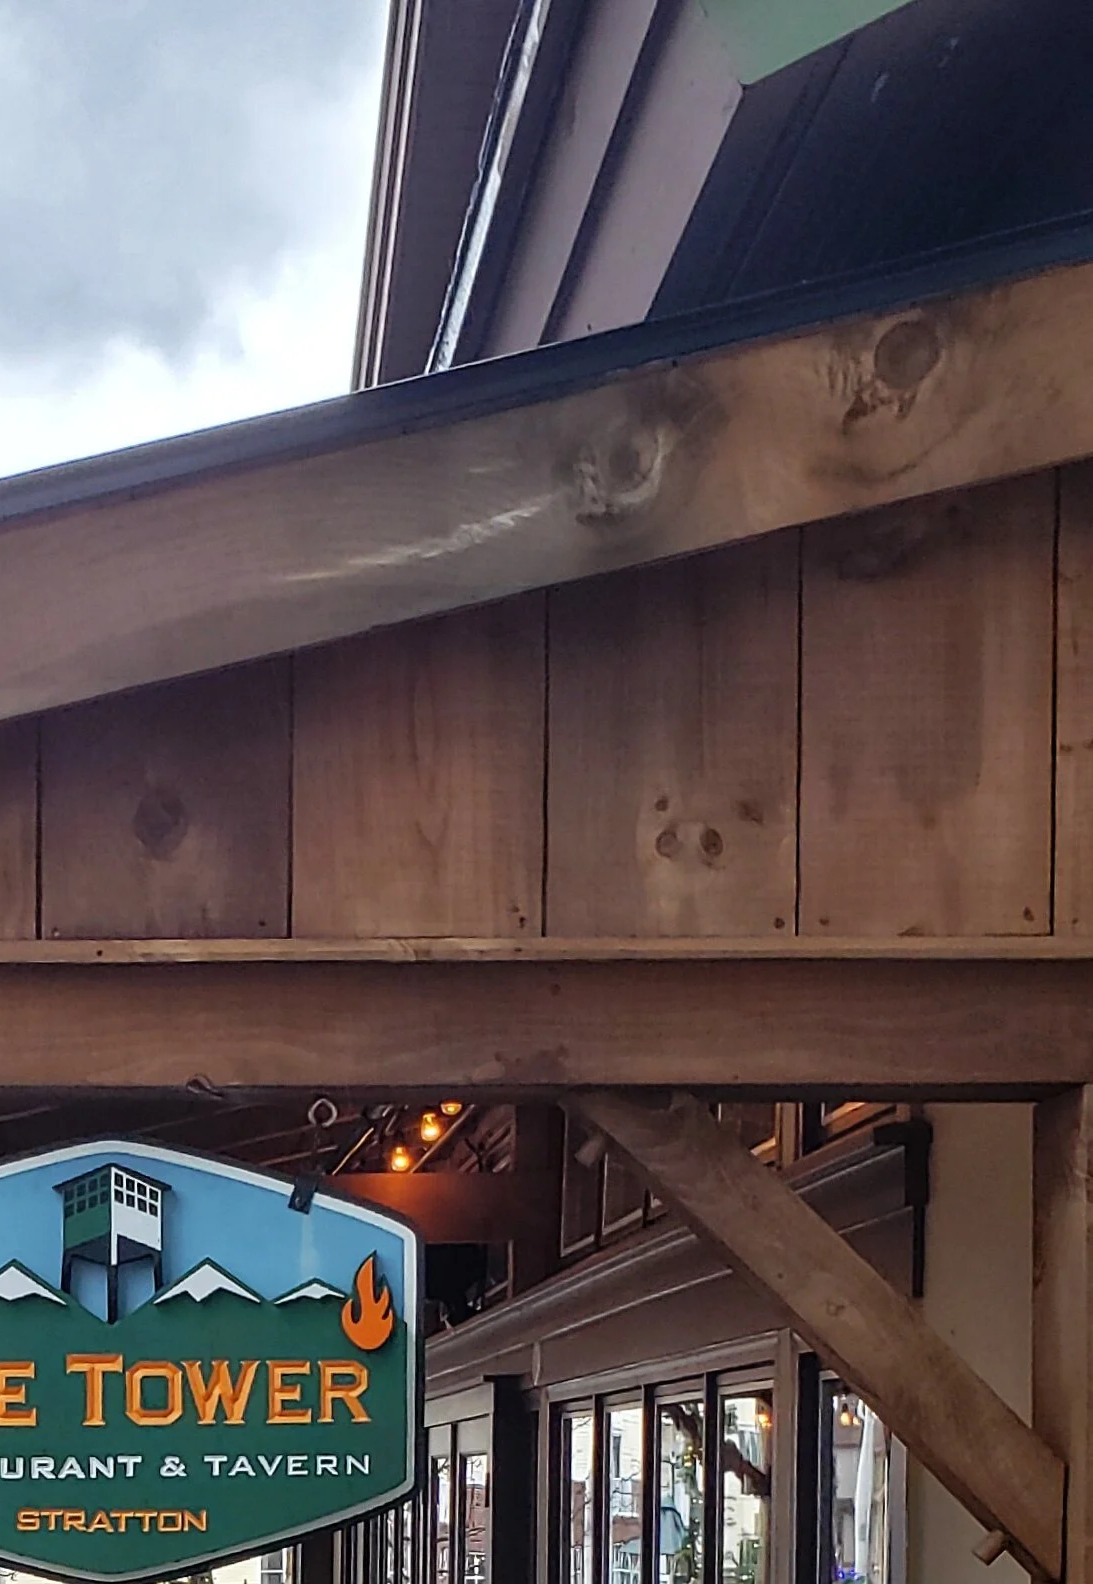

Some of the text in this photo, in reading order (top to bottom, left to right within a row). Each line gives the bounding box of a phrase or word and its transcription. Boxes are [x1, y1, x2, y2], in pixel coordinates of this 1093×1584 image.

[65, 1353, 372, 1426] TOWER
[160, 1456, 187, 1477] &
[204, 1454, 370, 1475] TAVERN
[16, 1508, 207, 1532] STRATTON
